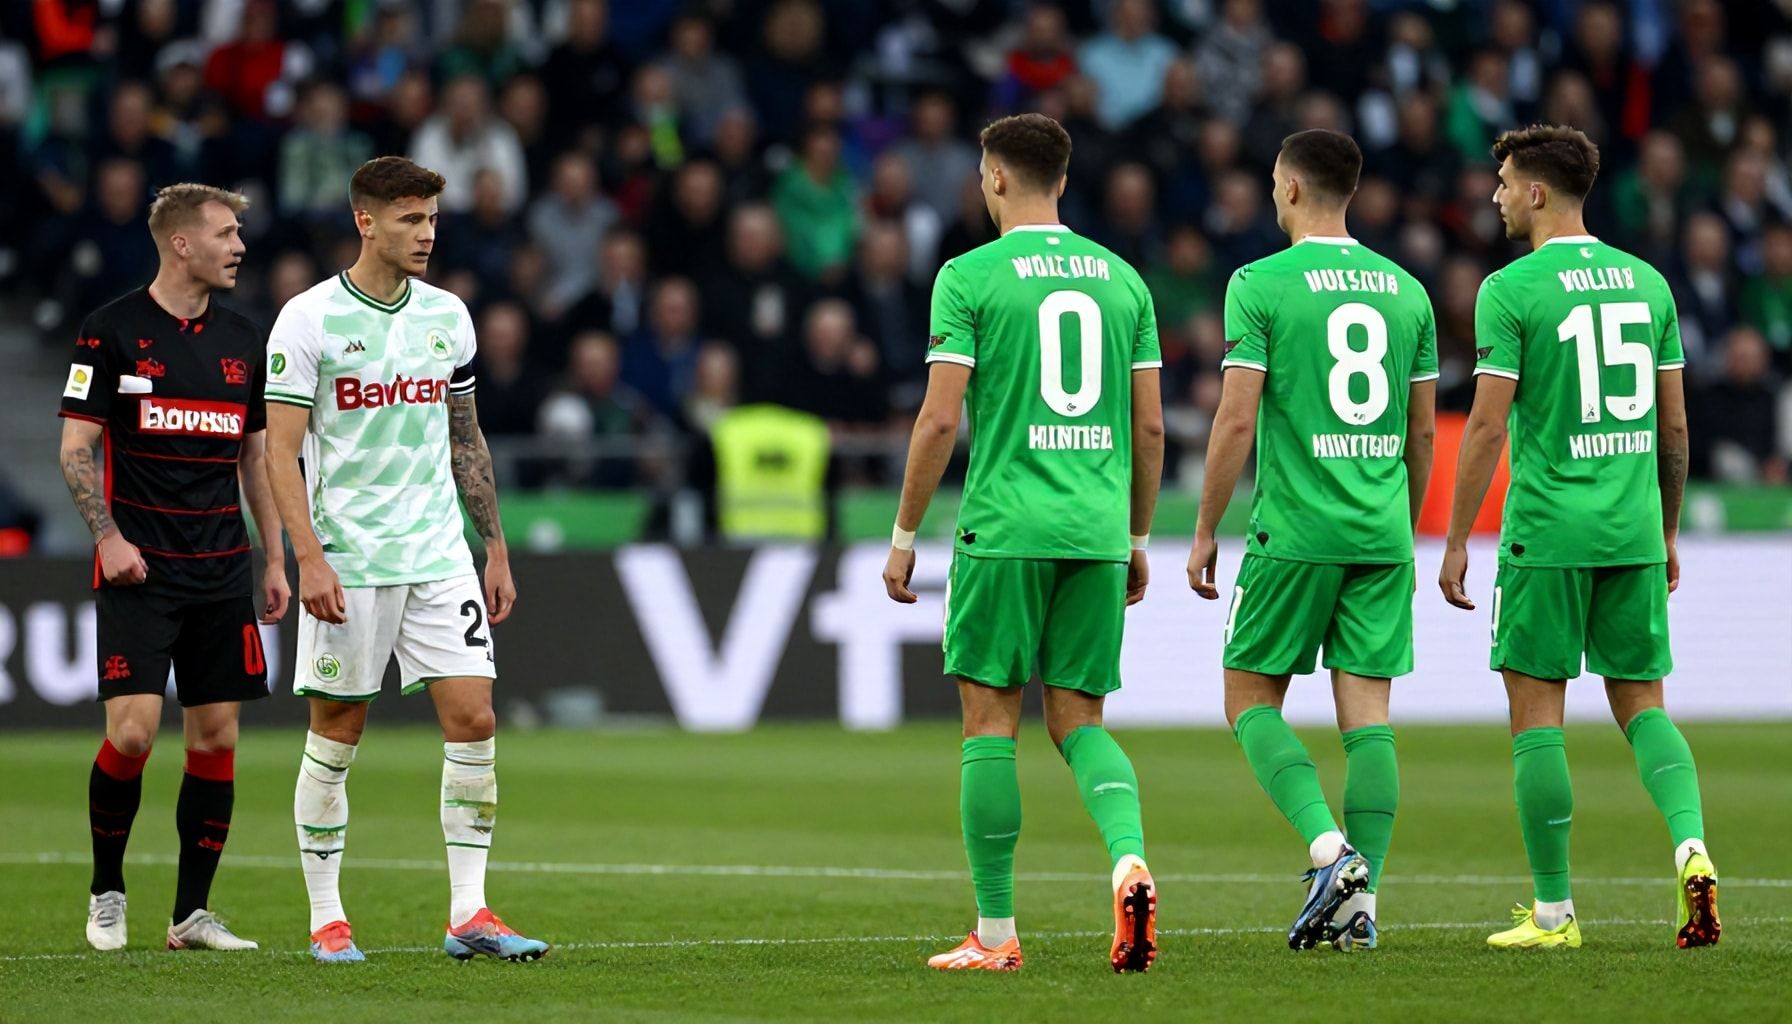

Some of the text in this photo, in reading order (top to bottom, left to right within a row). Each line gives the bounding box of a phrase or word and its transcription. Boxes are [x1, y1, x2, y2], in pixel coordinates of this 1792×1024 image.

[1038, 290, 1102, 417] 0
[1327, 302, 1389, 425] 8
[1556, 301, 1654, 423] 15
